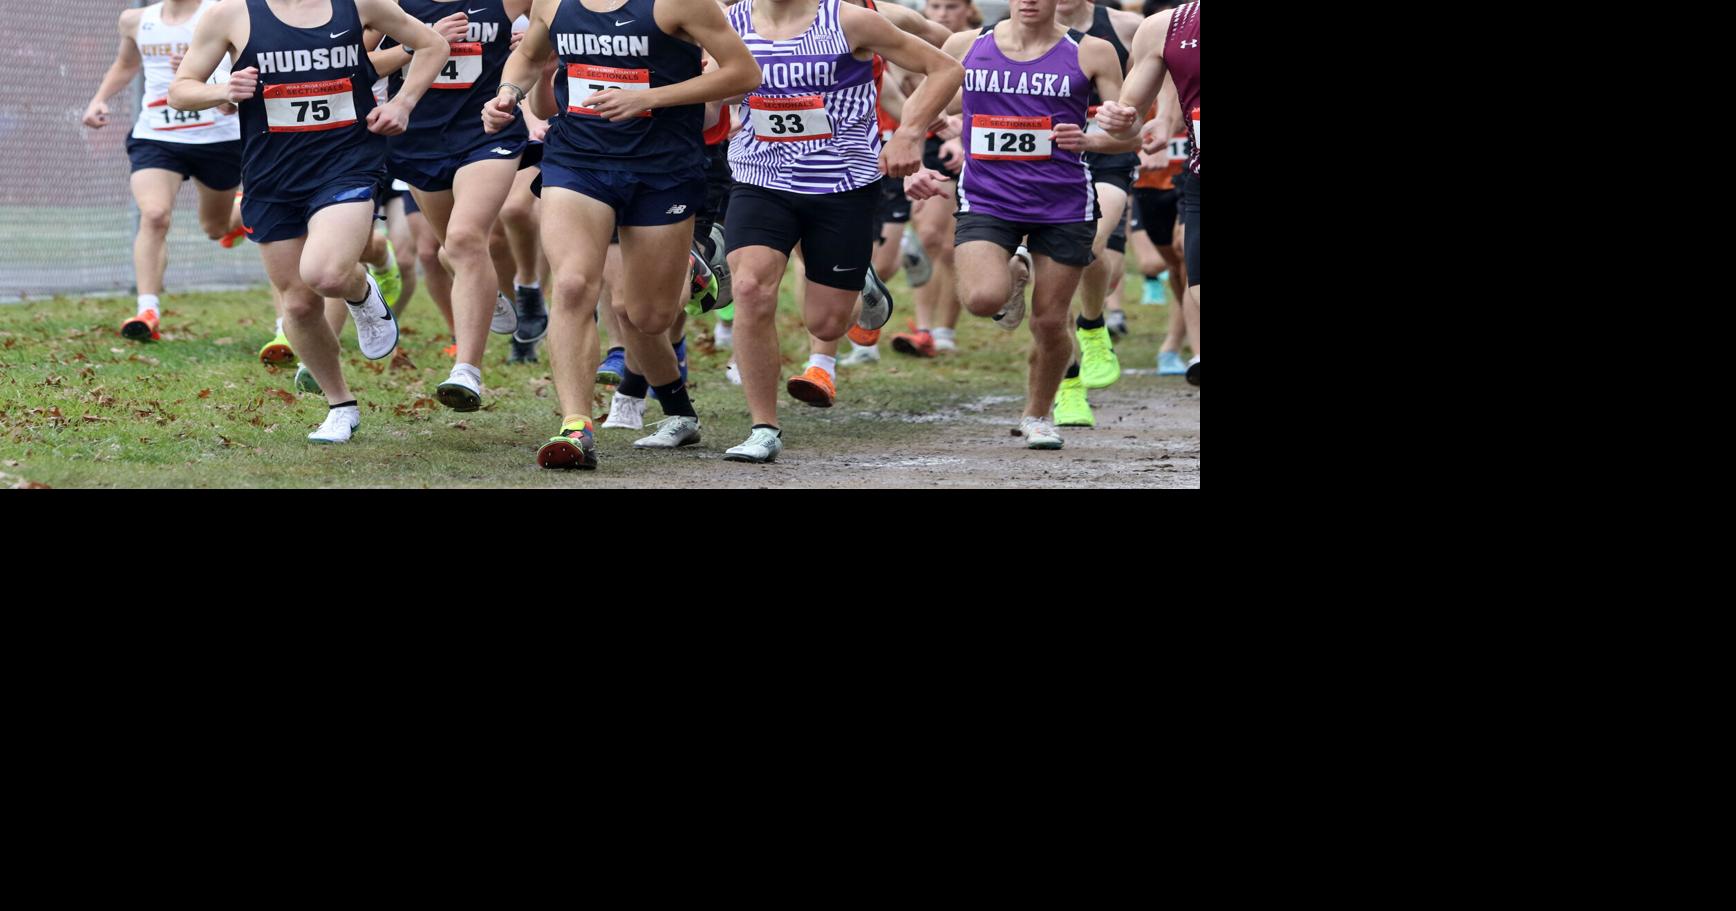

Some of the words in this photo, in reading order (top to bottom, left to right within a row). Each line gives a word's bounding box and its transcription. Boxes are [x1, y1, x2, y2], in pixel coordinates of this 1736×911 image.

[556, 33, 649, 56] HUDSON
[257, 44, 359, 74] HUDSON
[440, 60, 459, 80] 4
[587, 71, 639, 80] SECTIONALS
[287, 84, 343, 95] SECTIONALS
[965, 69, 1071, 97] ONALASKA
[161, 109, 200, 123] 144
[291, 99, 331, 122] 75
[768, 113, 805, 134] 33
[990, 120, 1042, 128] SECTIONALS
[984, 132, 1036, 152] 128
